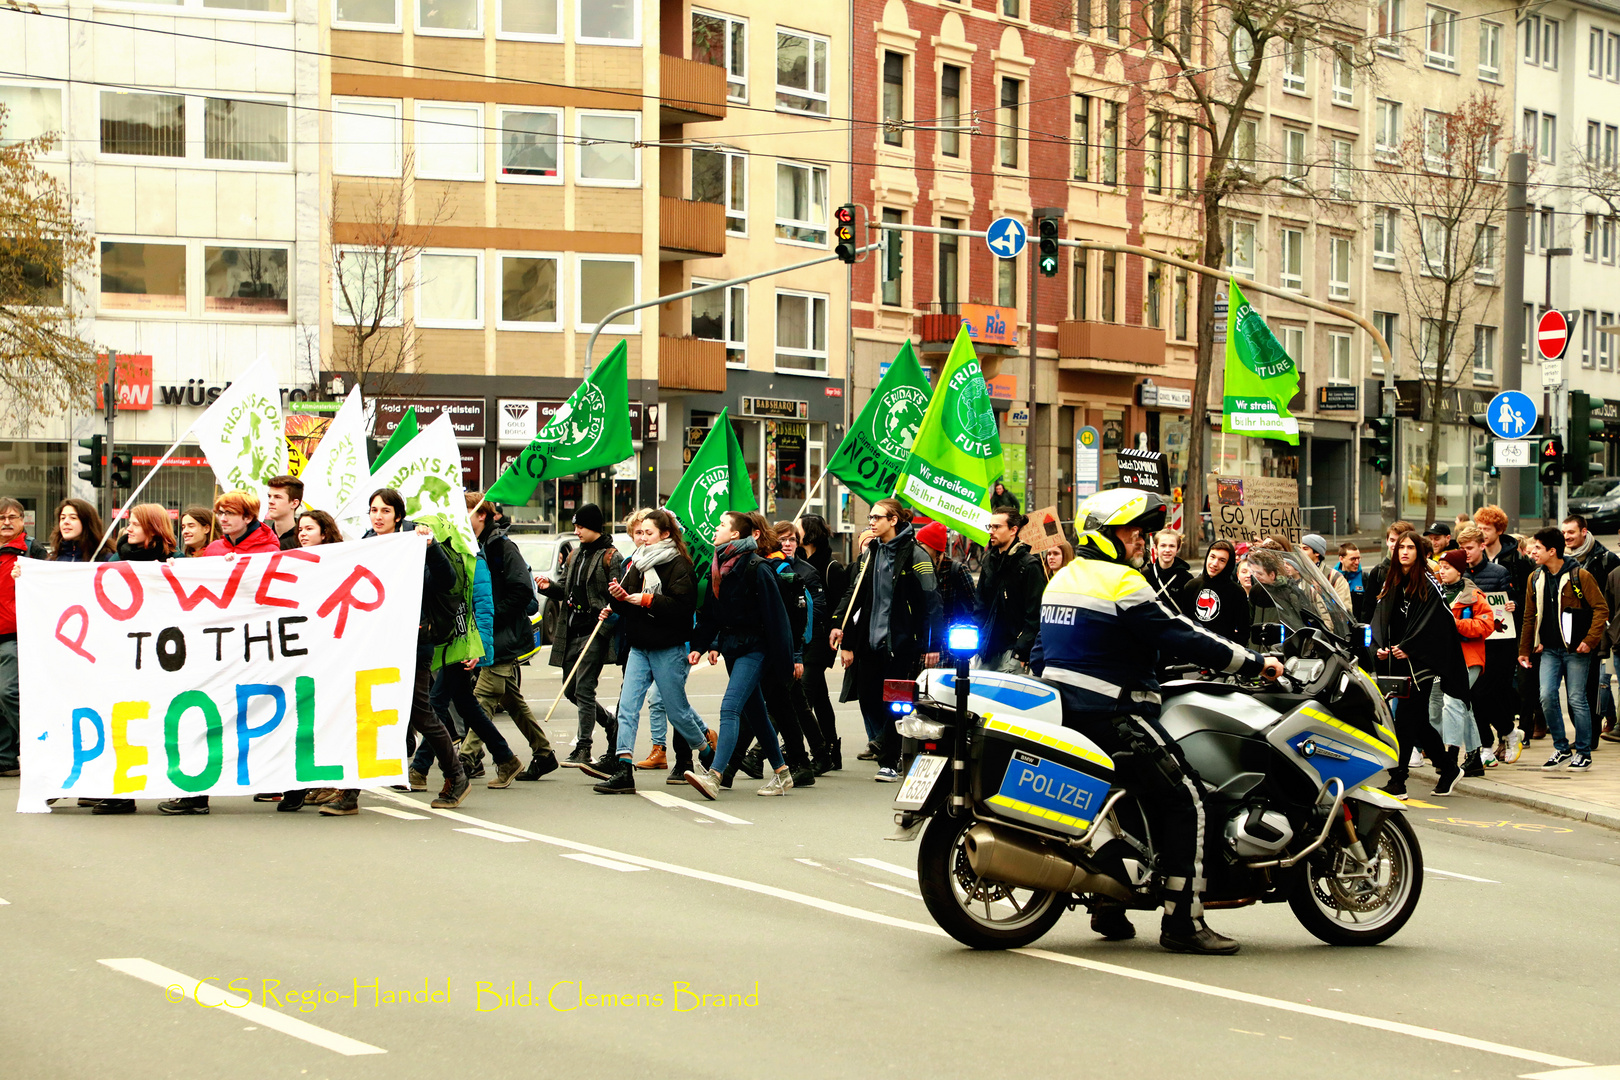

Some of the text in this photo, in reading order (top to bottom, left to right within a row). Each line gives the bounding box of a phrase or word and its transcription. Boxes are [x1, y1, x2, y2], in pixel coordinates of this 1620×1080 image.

[985, 309, 1006, 335] Ria
[756, 399, 794, 412] BABSHARQI
[883, 389, 924, 408] FRIDAYS
[442, 405, 481, 414] Edelstein
[541, 407, 556, 416] Gol
[1013, 411, 1028, 421] Ria
[588, 417, 601, 440] FOR
[1083, 434, 1091, 442] H
[858, 431, 881, 459] Climate
[386, 457, 441, 490] RIDAYS
[1118, 459, 1133, 470] Watch
[920, 463, 978, 503] Wir streiken,
[1123, 472, 1159, 488] on YouTube
[909, 480, 980, 522] bis Ihr handelt!
[1221, 505, 1300, 528] GO VEGAN
[1219, 525, 1238, 539] for
[1241, 527, 1257, 541] the
[55, 549, 385, 664] POWER
[1040, 605, 1077, 626] POLIZEI
[127, 616, 308, 672] TO THE
[61, 667, 403, 794] PEOPLE
[912, 758, 943, 778] RPL 4
[1020, 754, 1034, 763] BMW
[905, 780, 932, 800] 6328
[1018, 768, 1093, 810] POLIZEI
